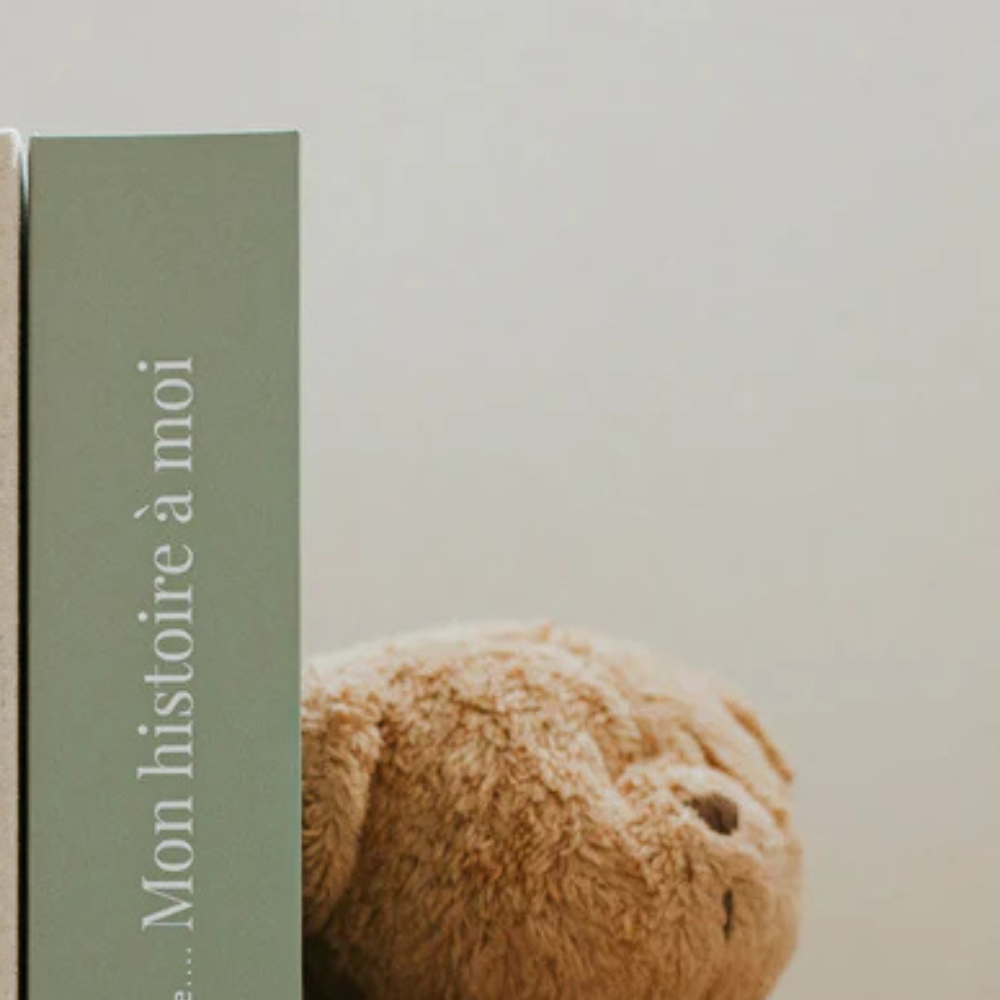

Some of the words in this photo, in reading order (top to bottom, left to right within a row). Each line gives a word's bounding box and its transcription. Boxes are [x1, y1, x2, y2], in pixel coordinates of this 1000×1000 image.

[136, 356, 195, 473] moi
[132, 489, 195, 524] à
[136, 543, 195, 780] histoire
[140, 795, 195, 932] Mon
